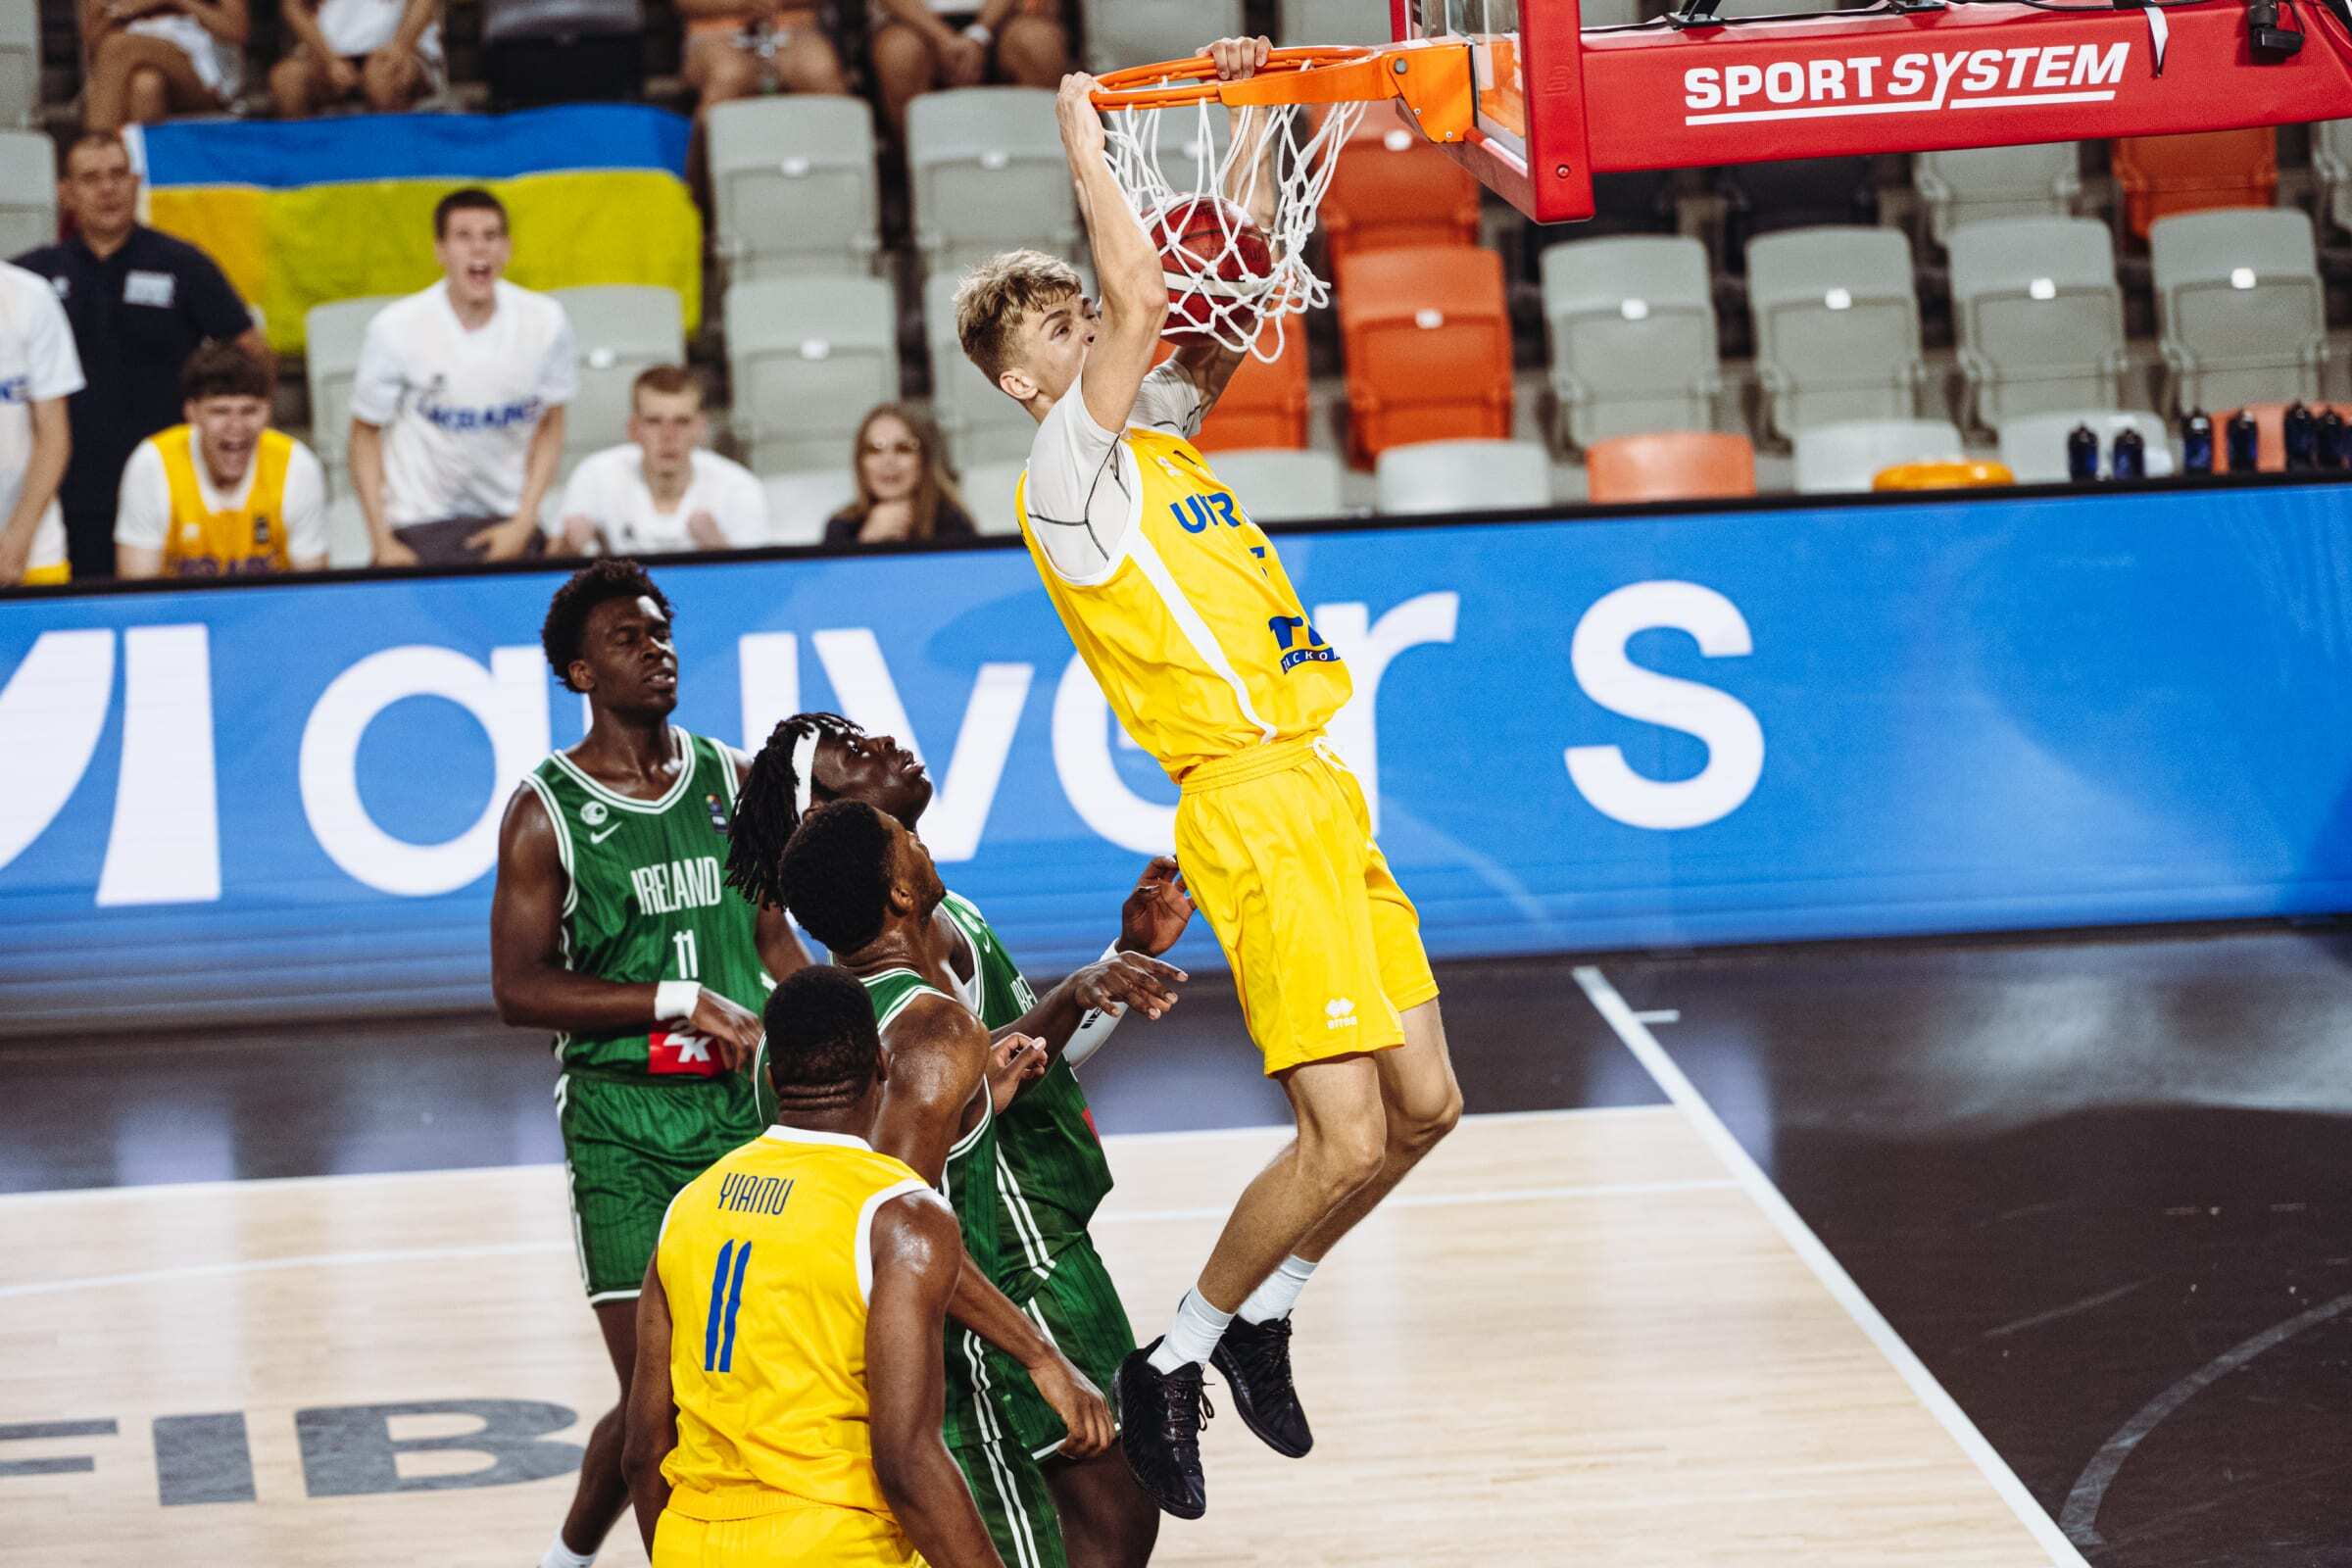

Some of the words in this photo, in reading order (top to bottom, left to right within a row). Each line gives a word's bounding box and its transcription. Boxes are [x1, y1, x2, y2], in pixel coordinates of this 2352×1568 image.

[630, 856, 721, 915] IRELAND
[672, 929, 699, 979] 11
[717, 1172, 795, 1215] YIAMU
[705, 1239, 752, 1372] 11
